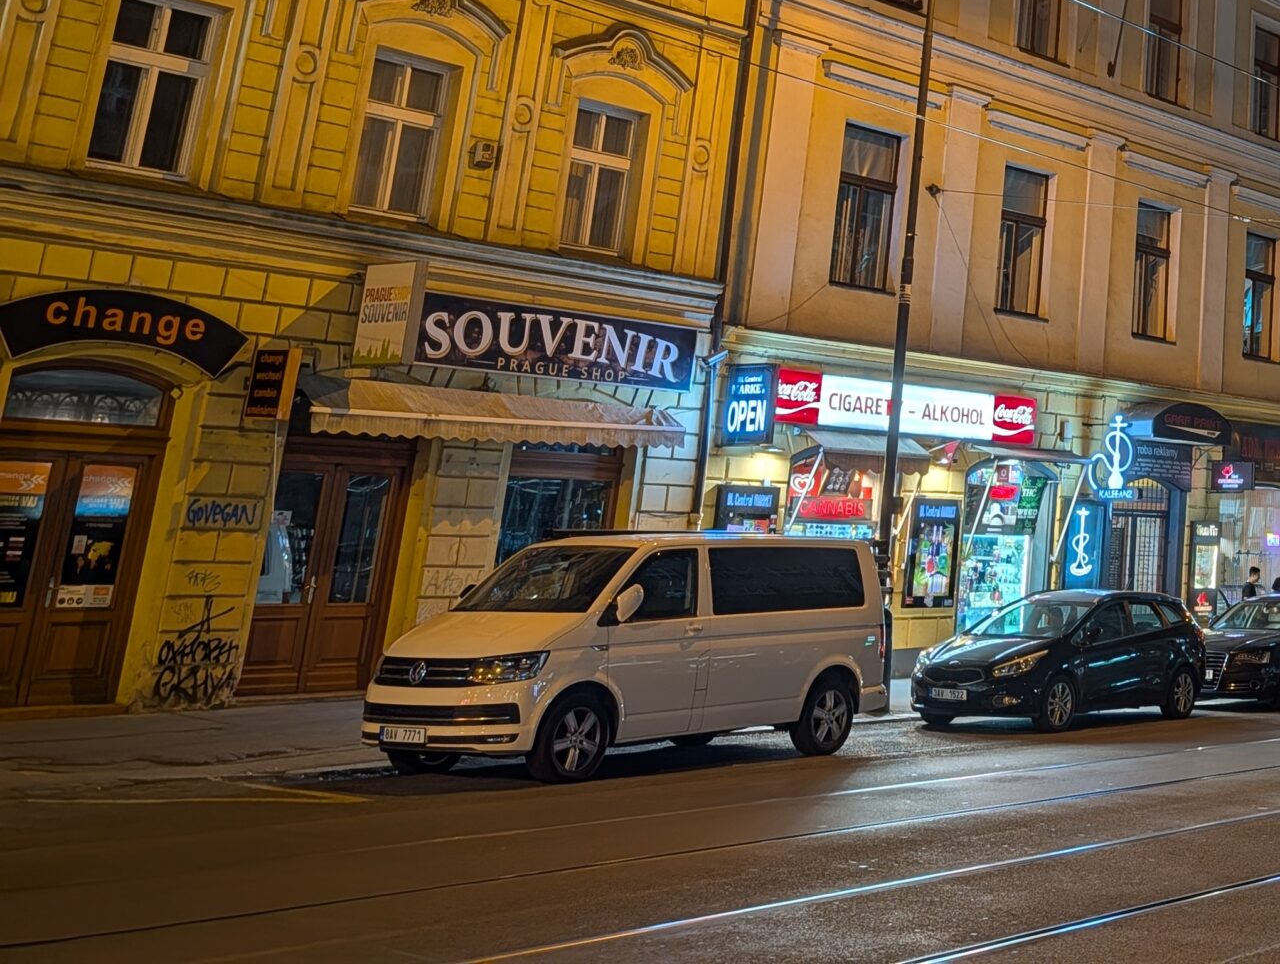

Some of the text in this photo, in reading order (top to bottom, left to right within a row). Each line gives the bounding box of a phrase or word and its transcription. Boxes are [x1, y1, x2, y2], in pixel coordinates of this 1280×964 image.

[46, 297, 206, 346] change
[361, 301, 409, 324] SOUVENIR
[424, 310, 680, 384] SOUVENIR
[259, 353, 284, 365] change
[497, 357, 626, 383] PRAGUE SHOP
[727, 400, 767, 433] OPEN
[828, 392, 903, 417] CIGARET
[921, 403, 985, 426] ALKOHOL
[994, 403, 1034, 425] Coca-Cola
[1136, 445, 1179, 459] roba reklamy
[1022, 488, 1037, 497] THC
[799, 499, 866, 517] CANNABIS
[1017, 508, 1038, 516] WEED
[384, 729, 422, 741] 8AV 7771
